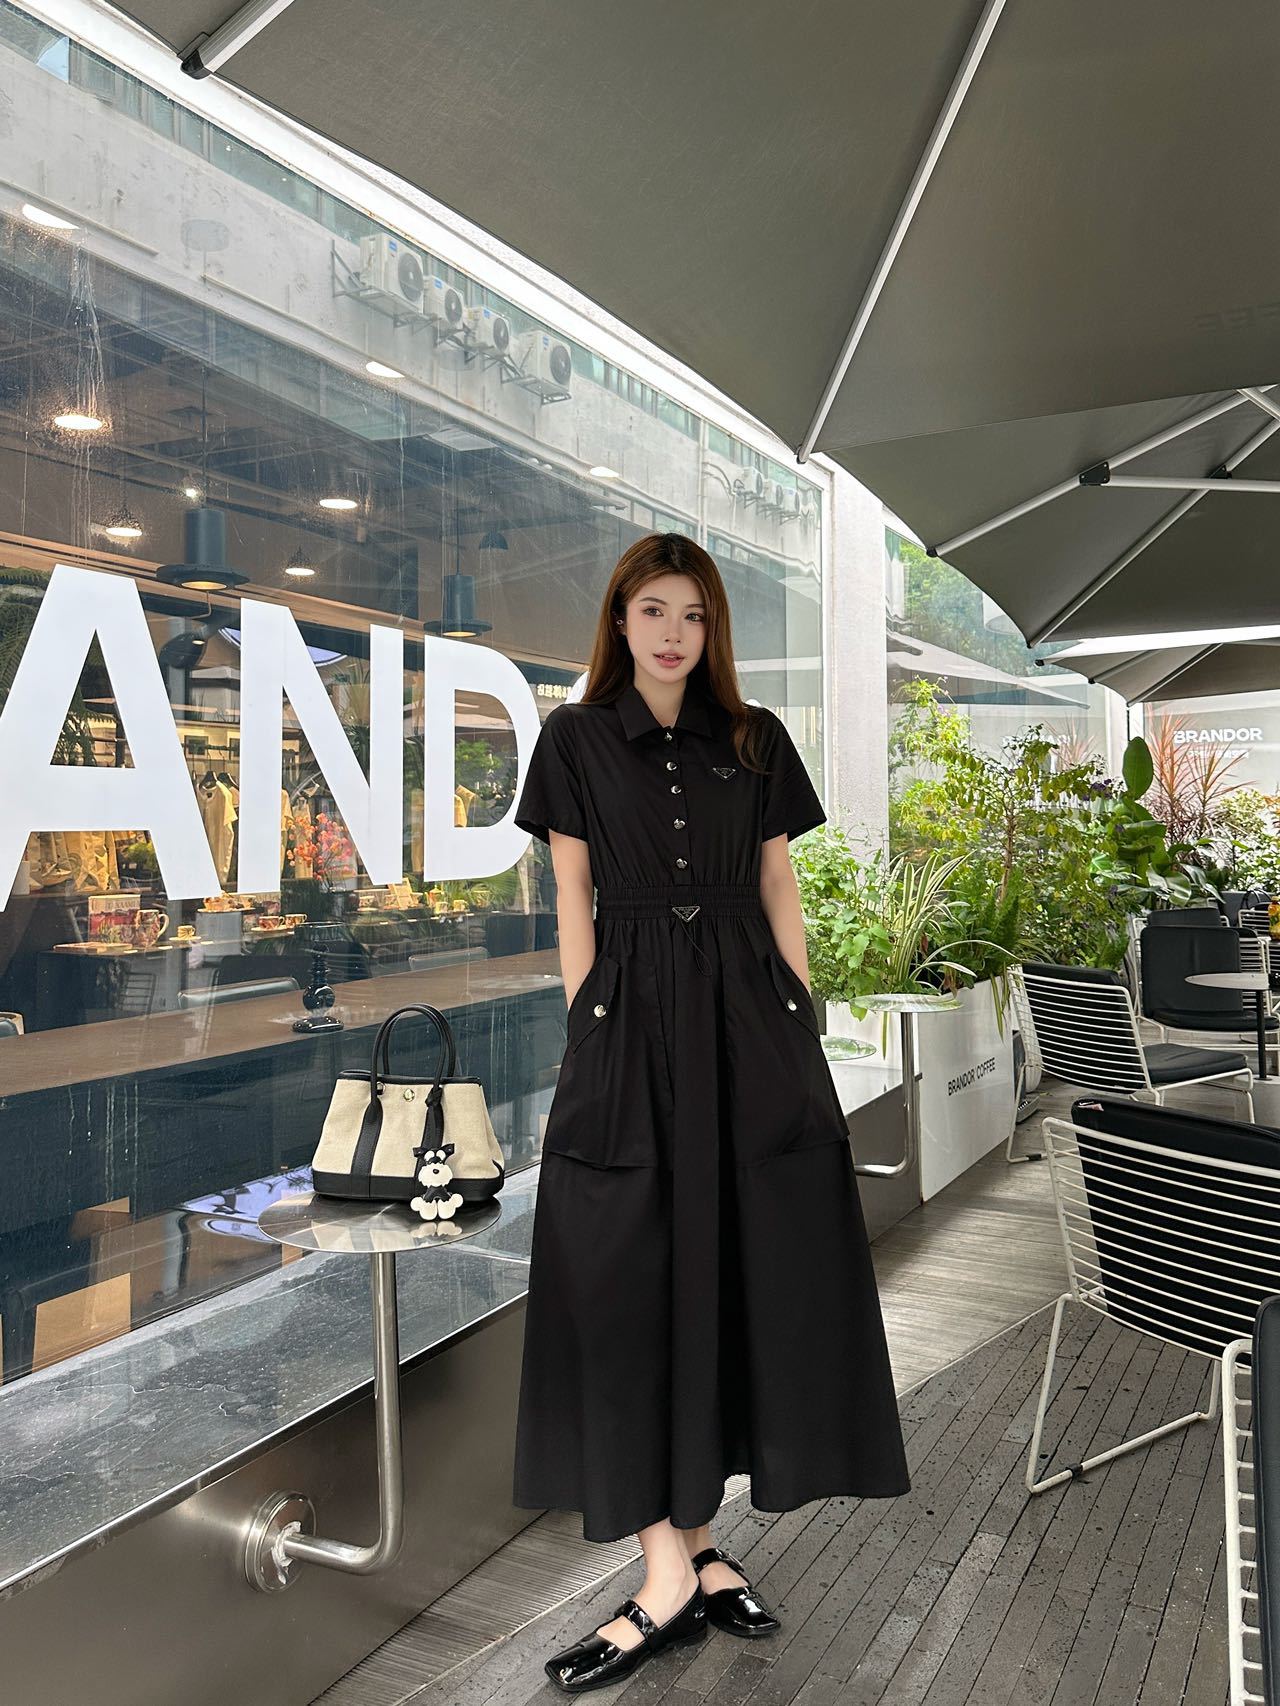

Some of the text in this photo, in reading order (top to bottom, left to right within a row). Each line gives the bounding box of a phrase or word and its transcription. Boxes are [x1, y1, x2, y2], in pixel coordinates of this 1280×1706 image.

[0, 563, 588, 912] AND
[1174, 727, 1263, 744] BRANDOR
[948, 1057, 995, 1096] BRANDOR COFFEE
